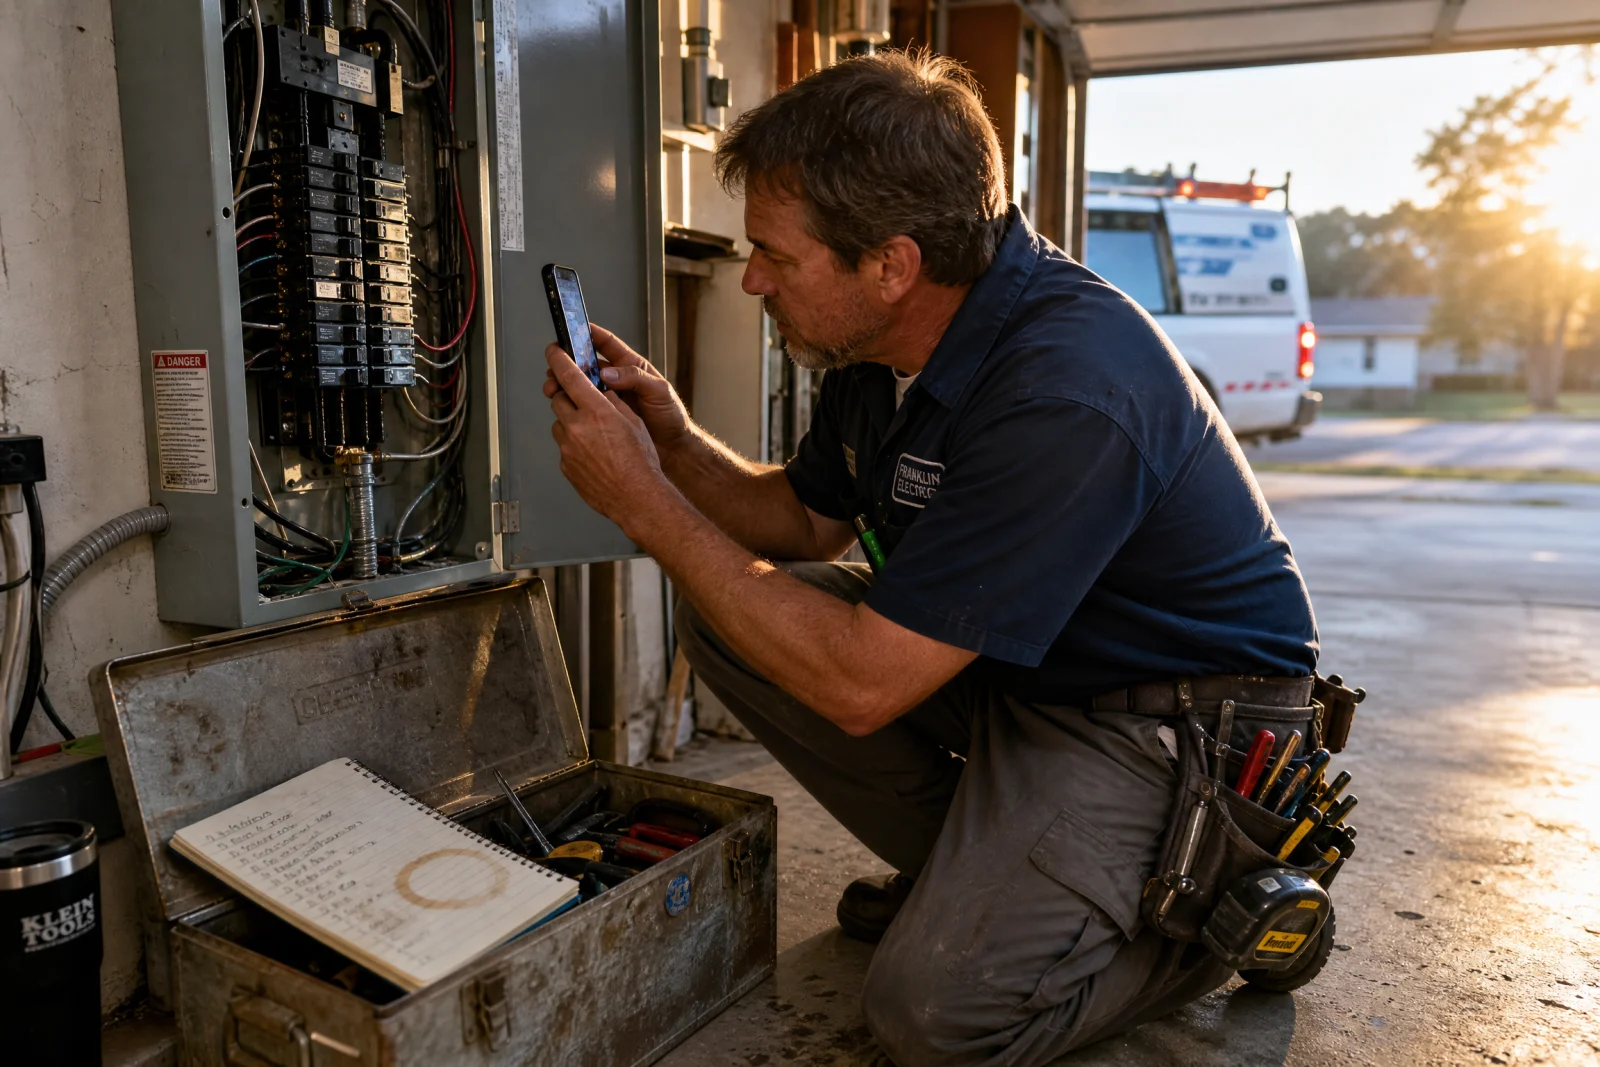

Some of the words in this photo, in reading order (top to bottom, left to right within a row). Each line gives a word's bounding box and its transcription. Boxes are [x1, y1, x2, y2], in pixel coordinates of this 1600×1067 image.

[167, 356, 201, 367] DANGER
[899, 464, 940, 485] FRANKLIN
[20, 893, 94, 933] KLEIN
[22, 908, 95, 945] TOOLS
